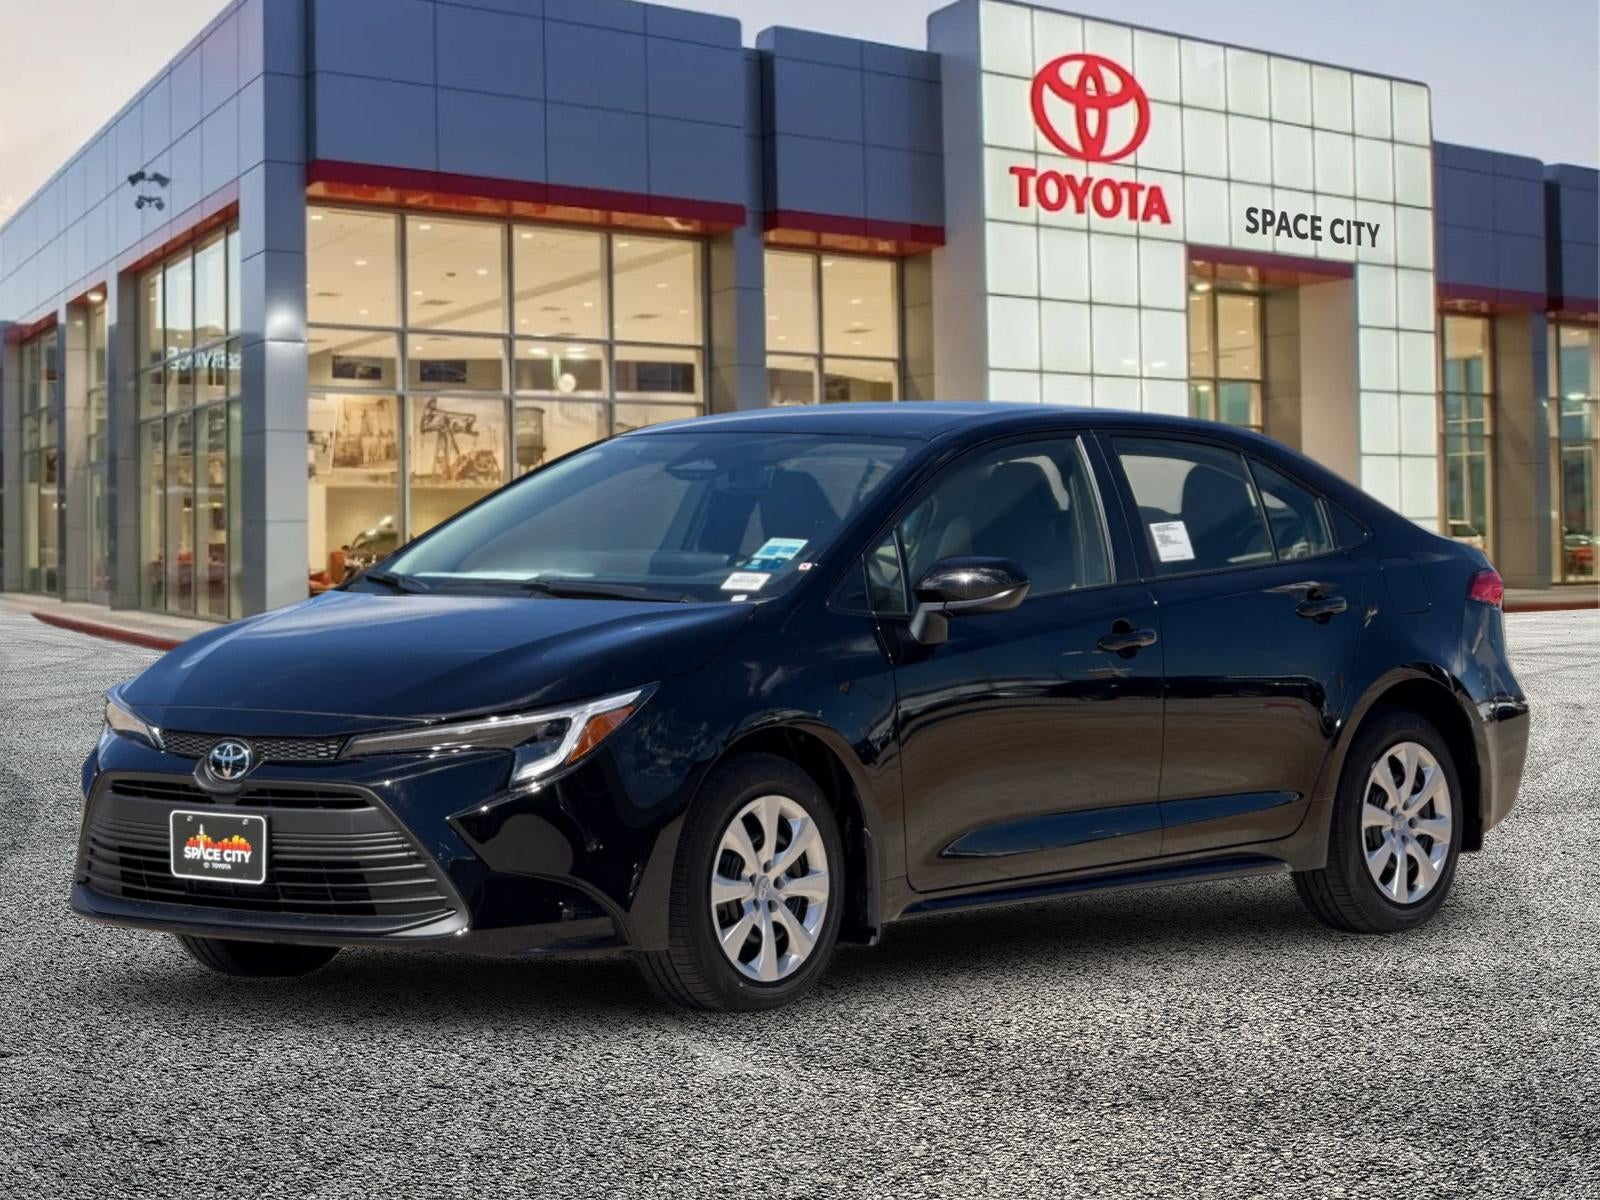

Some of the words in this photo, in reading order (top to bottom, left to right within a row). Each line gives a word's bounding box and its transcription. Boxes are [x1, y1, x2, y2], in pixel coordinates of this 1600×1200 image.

[1009, 166, 1170, 224] TOYOTA
[1245, 206, 1323, 242] SPACE
[1329, 218, 1380, 248] CITY
[183, 845, 221, 861] SPACE
[223, 849, 252, 863] CITY
[211, 862, 231, 870] TOYOTA
